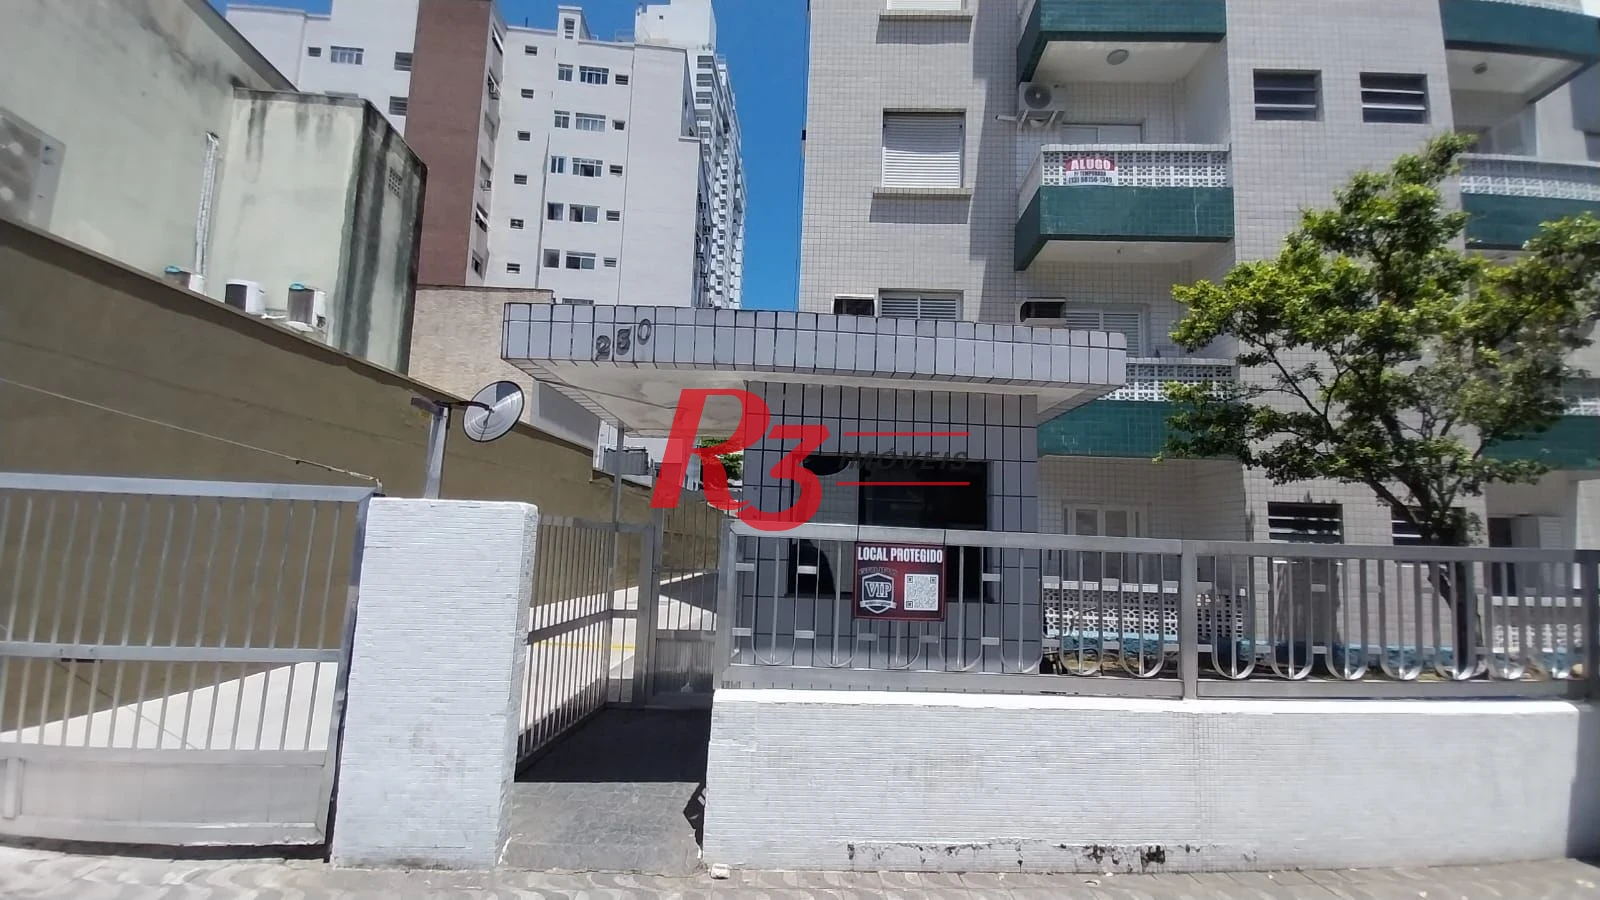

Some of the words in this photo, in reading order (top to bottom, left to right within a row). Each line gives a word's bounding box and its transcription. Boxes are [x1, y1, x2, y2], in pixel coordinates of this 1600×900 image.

[1071, 159, 1111, 170] ALUGO
[857, 546, 889, 561] LOCAL
[890, 547, 943, 564] PROTEGIDO
[865, 581, 893, 598] VIP
